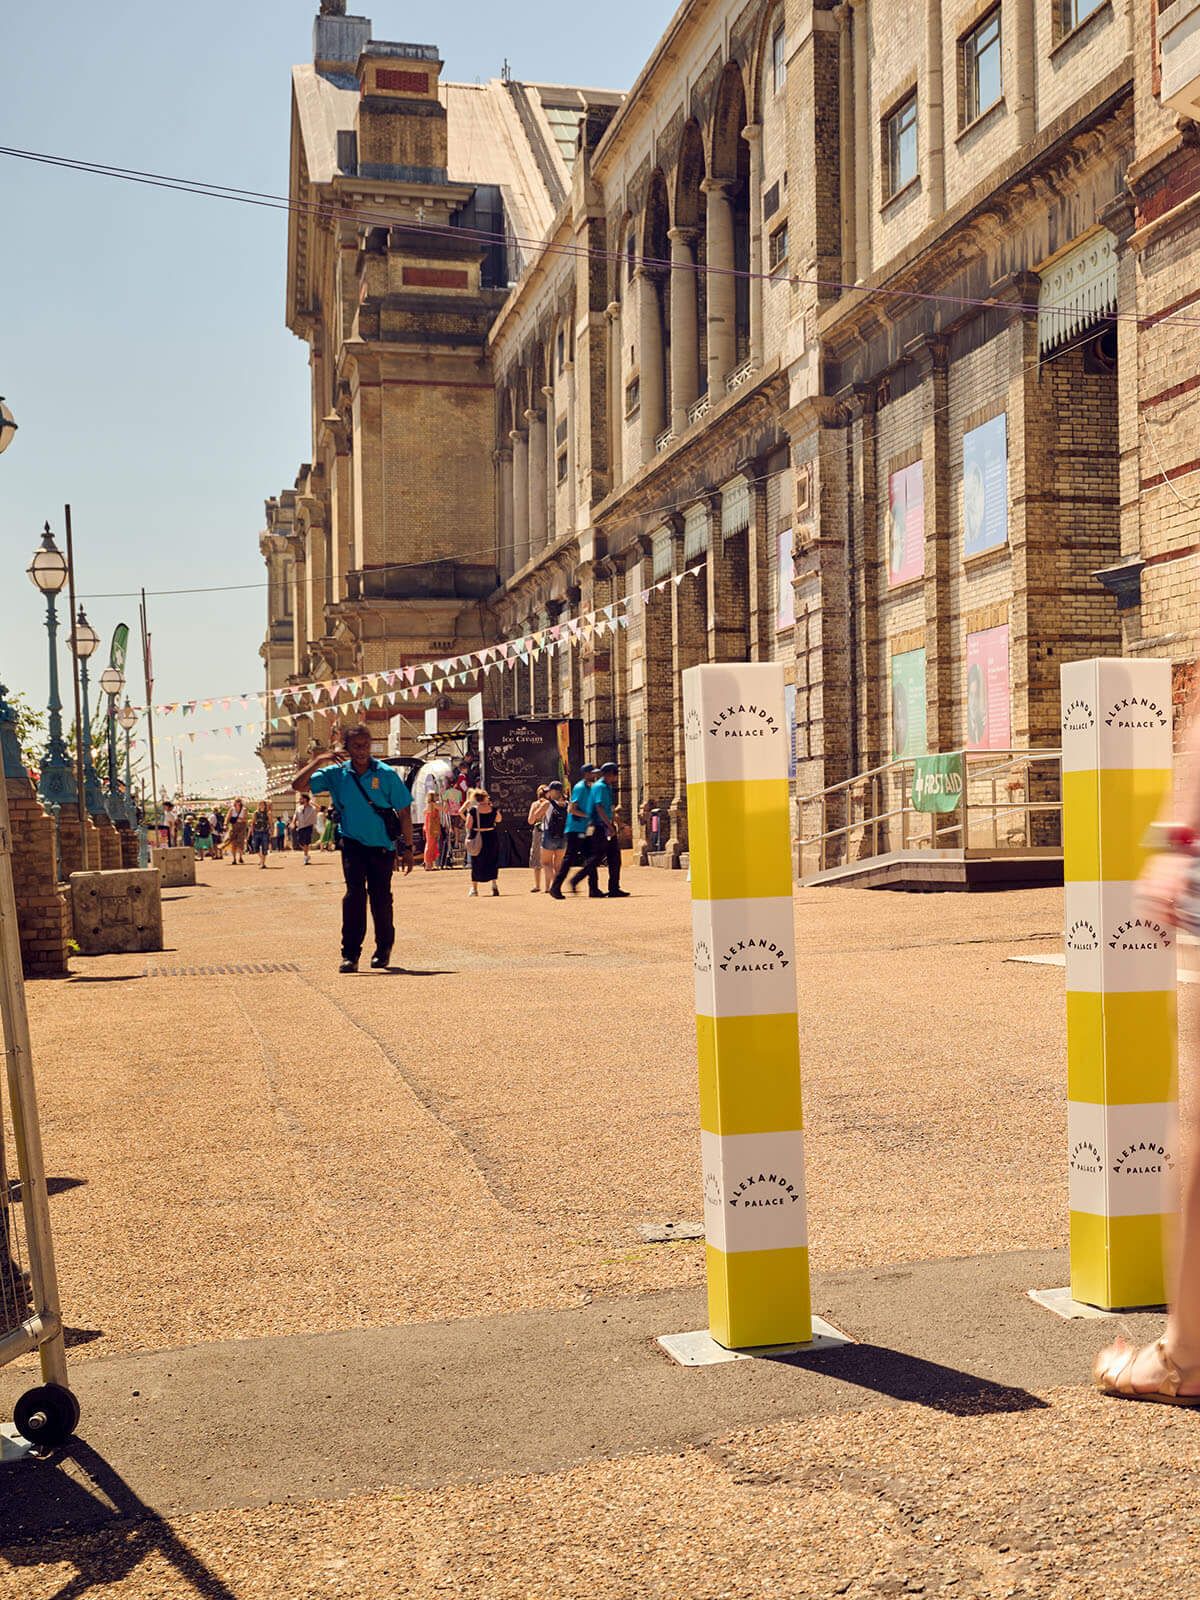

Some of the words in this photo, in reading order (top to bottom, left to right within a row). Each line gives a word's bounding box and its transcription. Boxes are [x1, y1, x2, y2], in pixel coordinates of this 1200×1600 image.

[709, 704, 779, 736] ALEXANDRA
[1104, 697, 1167, 727] ALEXANDRA
[725, 729, 764, 737] PALACE
[944, 772, 962, 793] AID
[1108, 919, 1171, 949] ALEXANDRA
[1122, 942, 1158, 950] PALACE
[719, 939, 789, 971] ALEXANDRA
[735, 963, 774, 972] PALACE
[1113, 1142, 1175, 1173] ALEXANDRA
[1126, 1166, 1161, 1174] PALACE
[729, 1174, 799, 1207] ALEXANDRA
[745, 1198, 784, 1207] PALACE
